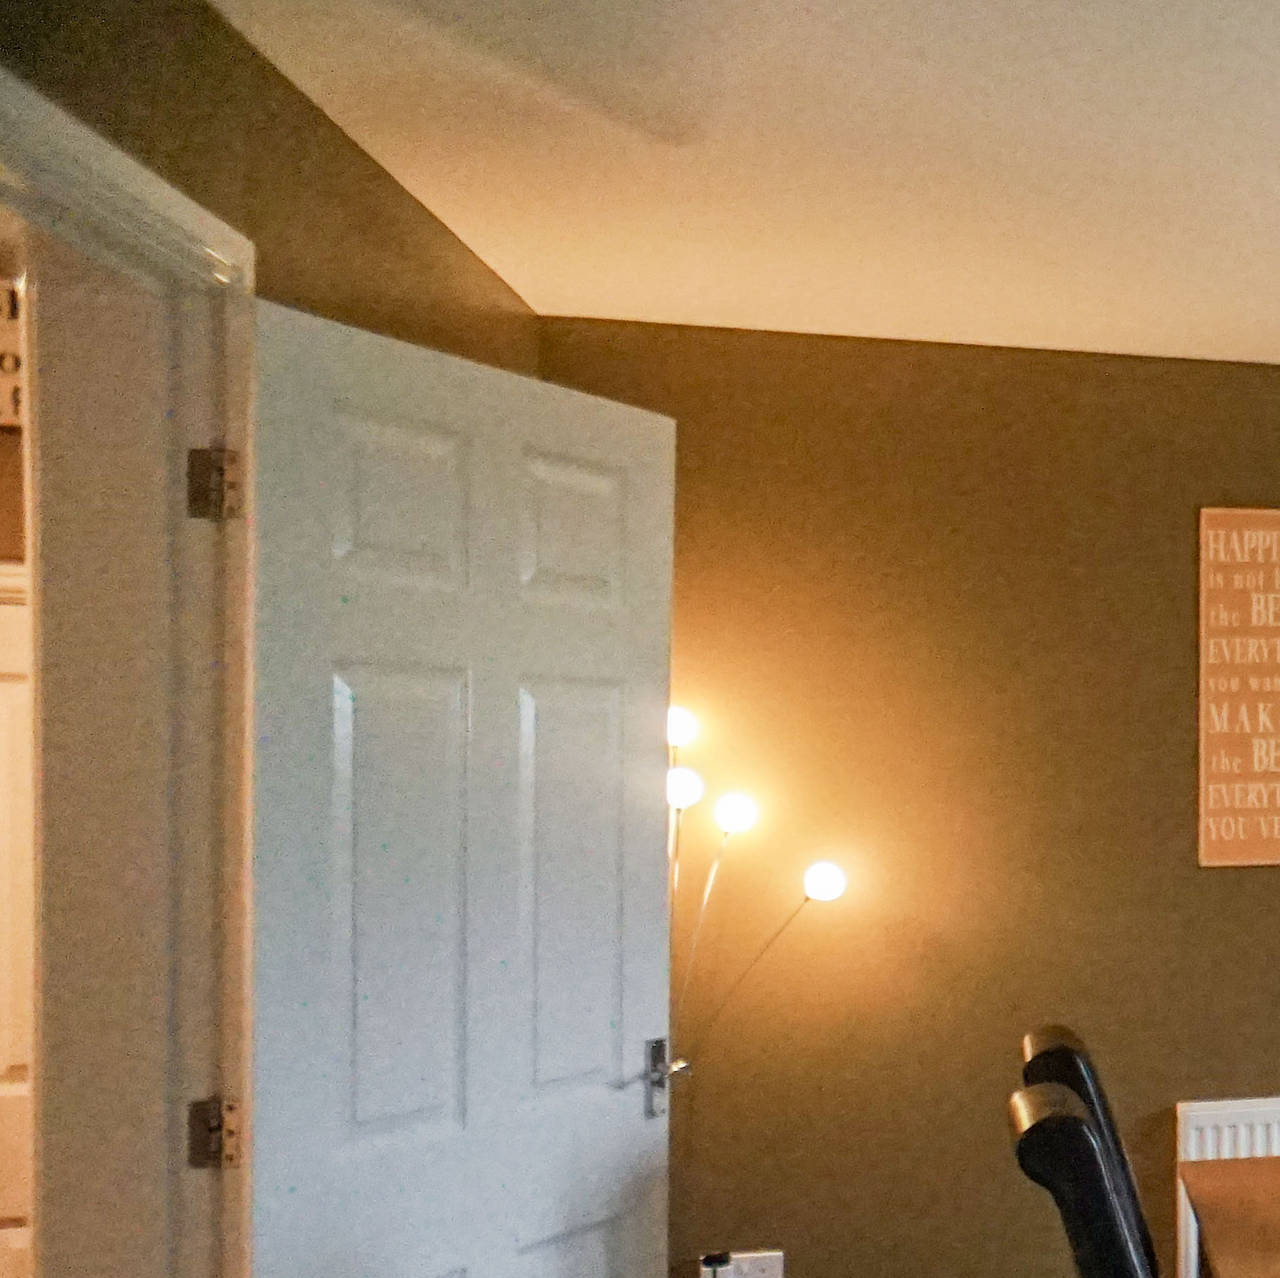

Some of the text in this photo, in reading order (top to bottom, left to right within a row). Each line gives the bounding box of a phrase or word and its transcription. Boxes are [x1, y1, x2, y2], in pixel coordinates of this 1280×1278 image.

[1208, 567, 1224, 589] is
[1233, 569, 1264, 590] not
[1209, 603, 1240, 627] the
[1211, 750, 1242, 773] the
